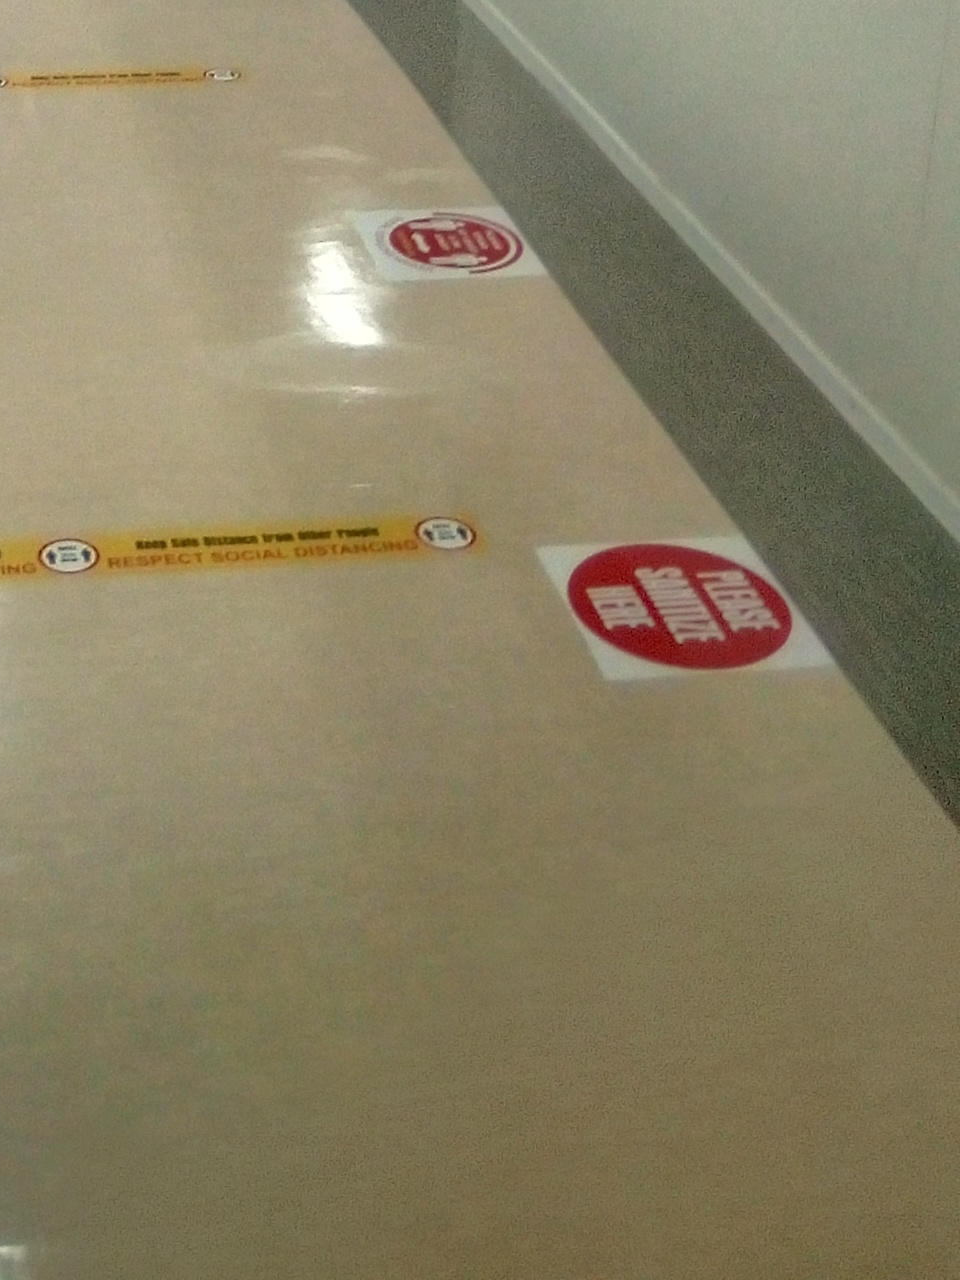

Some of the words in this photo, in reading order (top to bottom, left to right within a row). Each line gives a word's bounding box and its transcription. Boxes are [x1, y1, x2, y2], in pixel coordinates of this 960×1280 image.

[107, 551, 203, 569] RESPECT
[211, 547, 288, 564] SOCIAL
[294, 539, 419, 558] DISTANCING
[586, 583, 656, 632] HERE
[634, 567, 727, 645] SANITIZE
[696, 570, 781, 632] PLEASE
